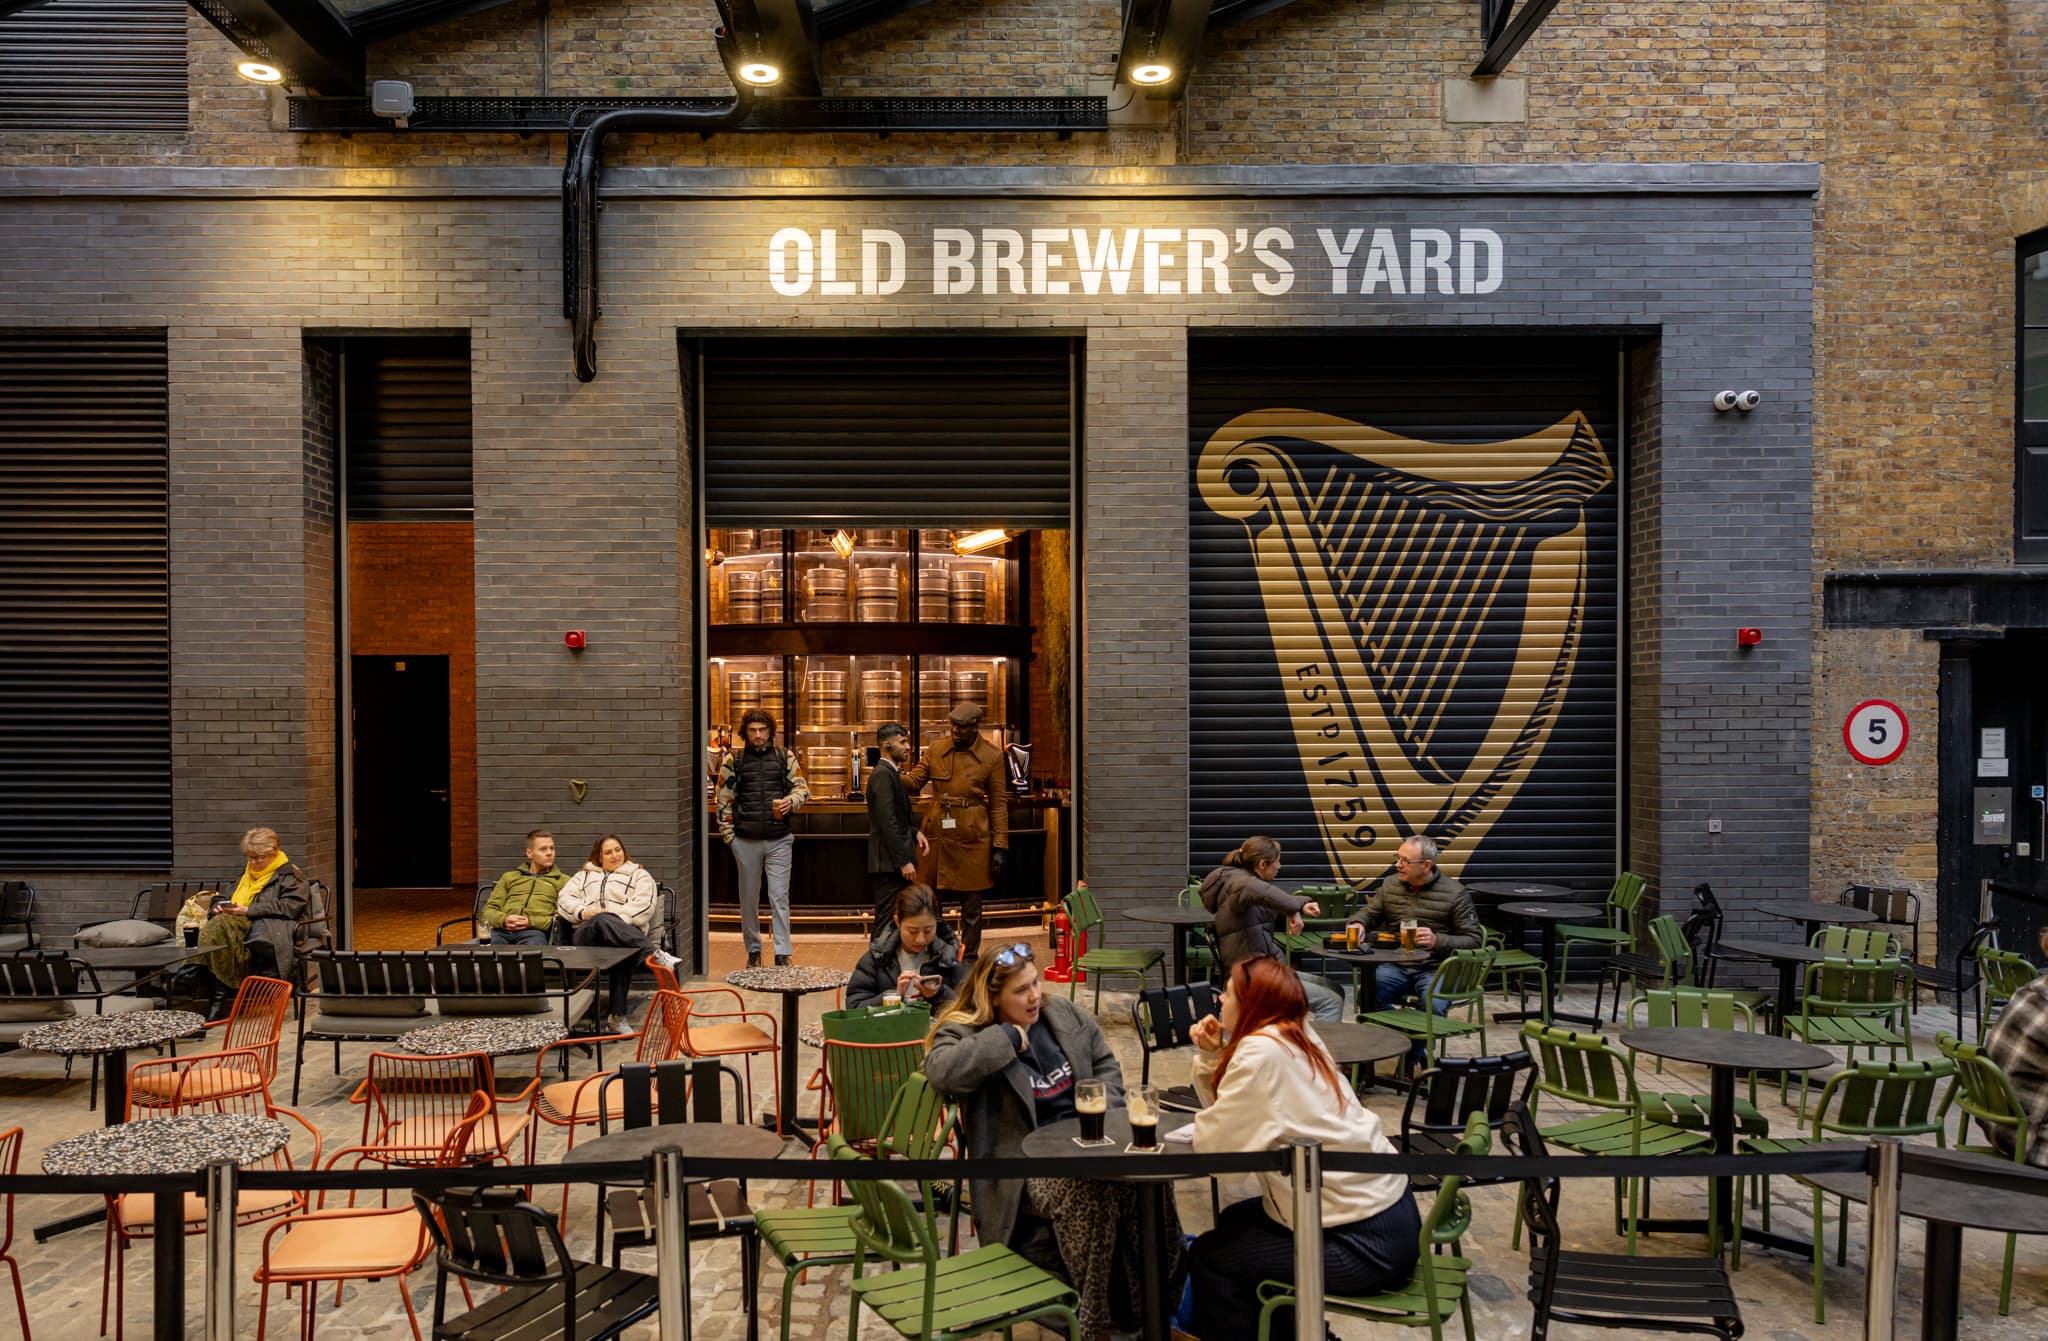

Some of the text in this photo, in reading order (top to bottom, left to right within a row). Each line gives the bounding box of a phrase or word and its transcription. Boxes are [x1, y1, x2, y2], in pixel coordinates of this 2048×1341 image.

[769, 227, 1504, 297] OLD BREWER'S YARD
[1868, 719, 1887, 744] 5
[1318, 751, 1377, 848] 1759
